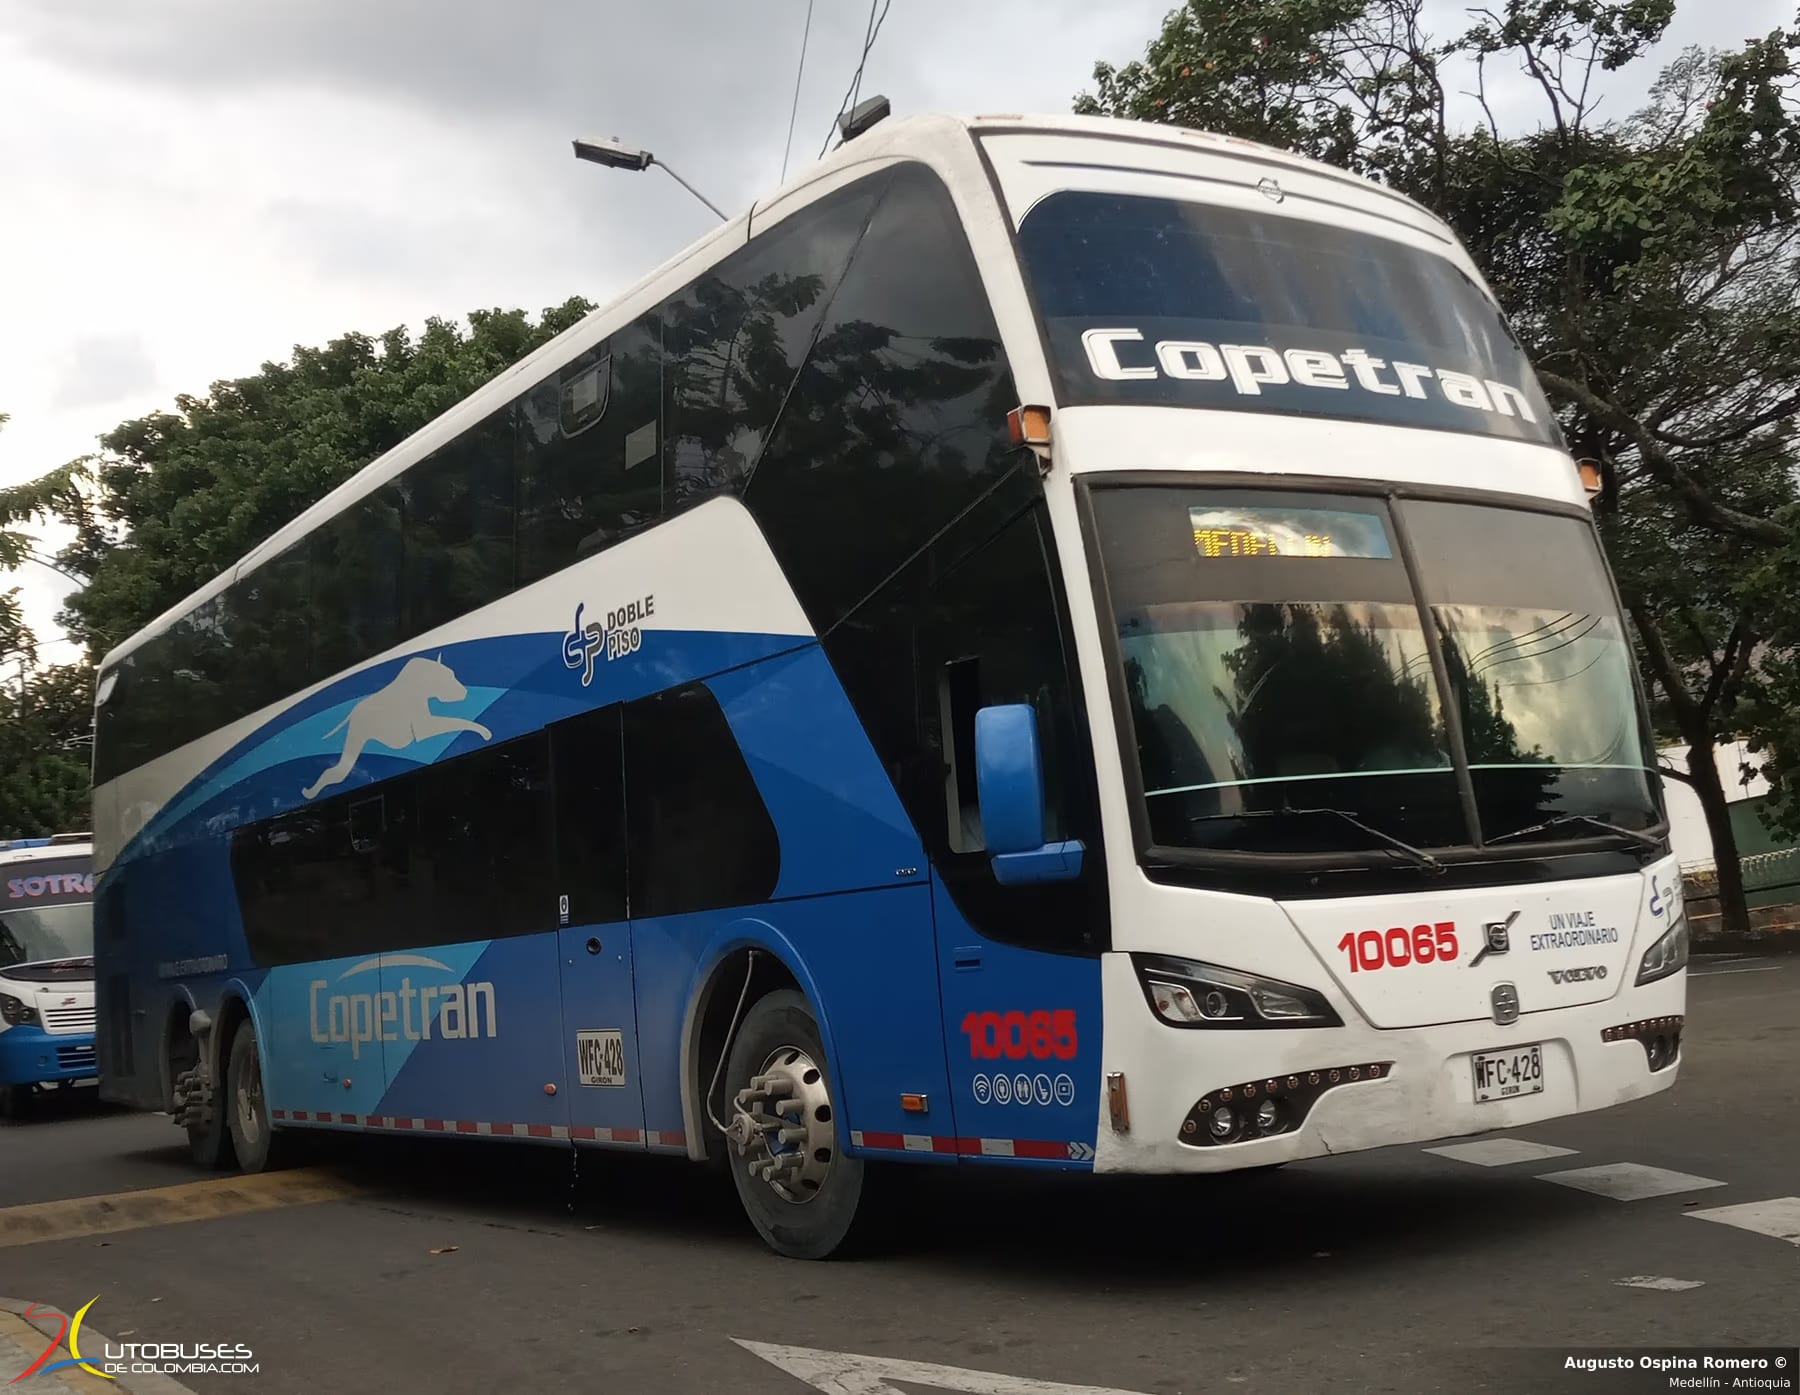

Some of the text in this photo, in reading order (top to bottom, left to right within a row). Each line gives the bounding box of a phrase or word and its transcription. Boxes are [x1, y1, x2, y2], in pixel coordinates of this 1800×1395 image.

[1081, 327, 1537, 424] Copetran
[607, 594, 655, 632] DOBLE
[607, 627, 641, 660] PISO
[1549, 911, 1596, 930] UN VIAJE
[1337, 921, 1459, 973] 10065
[1530, 927, 1618, 951] EXTRAORDINARIO
[1546, 965, 1608, 985] VOLVO
[309, 976, 497, 1060] Copetran
[960, 1009, 1079, 1060] 10065
[590, 1076, 613, 1084] GIRON
